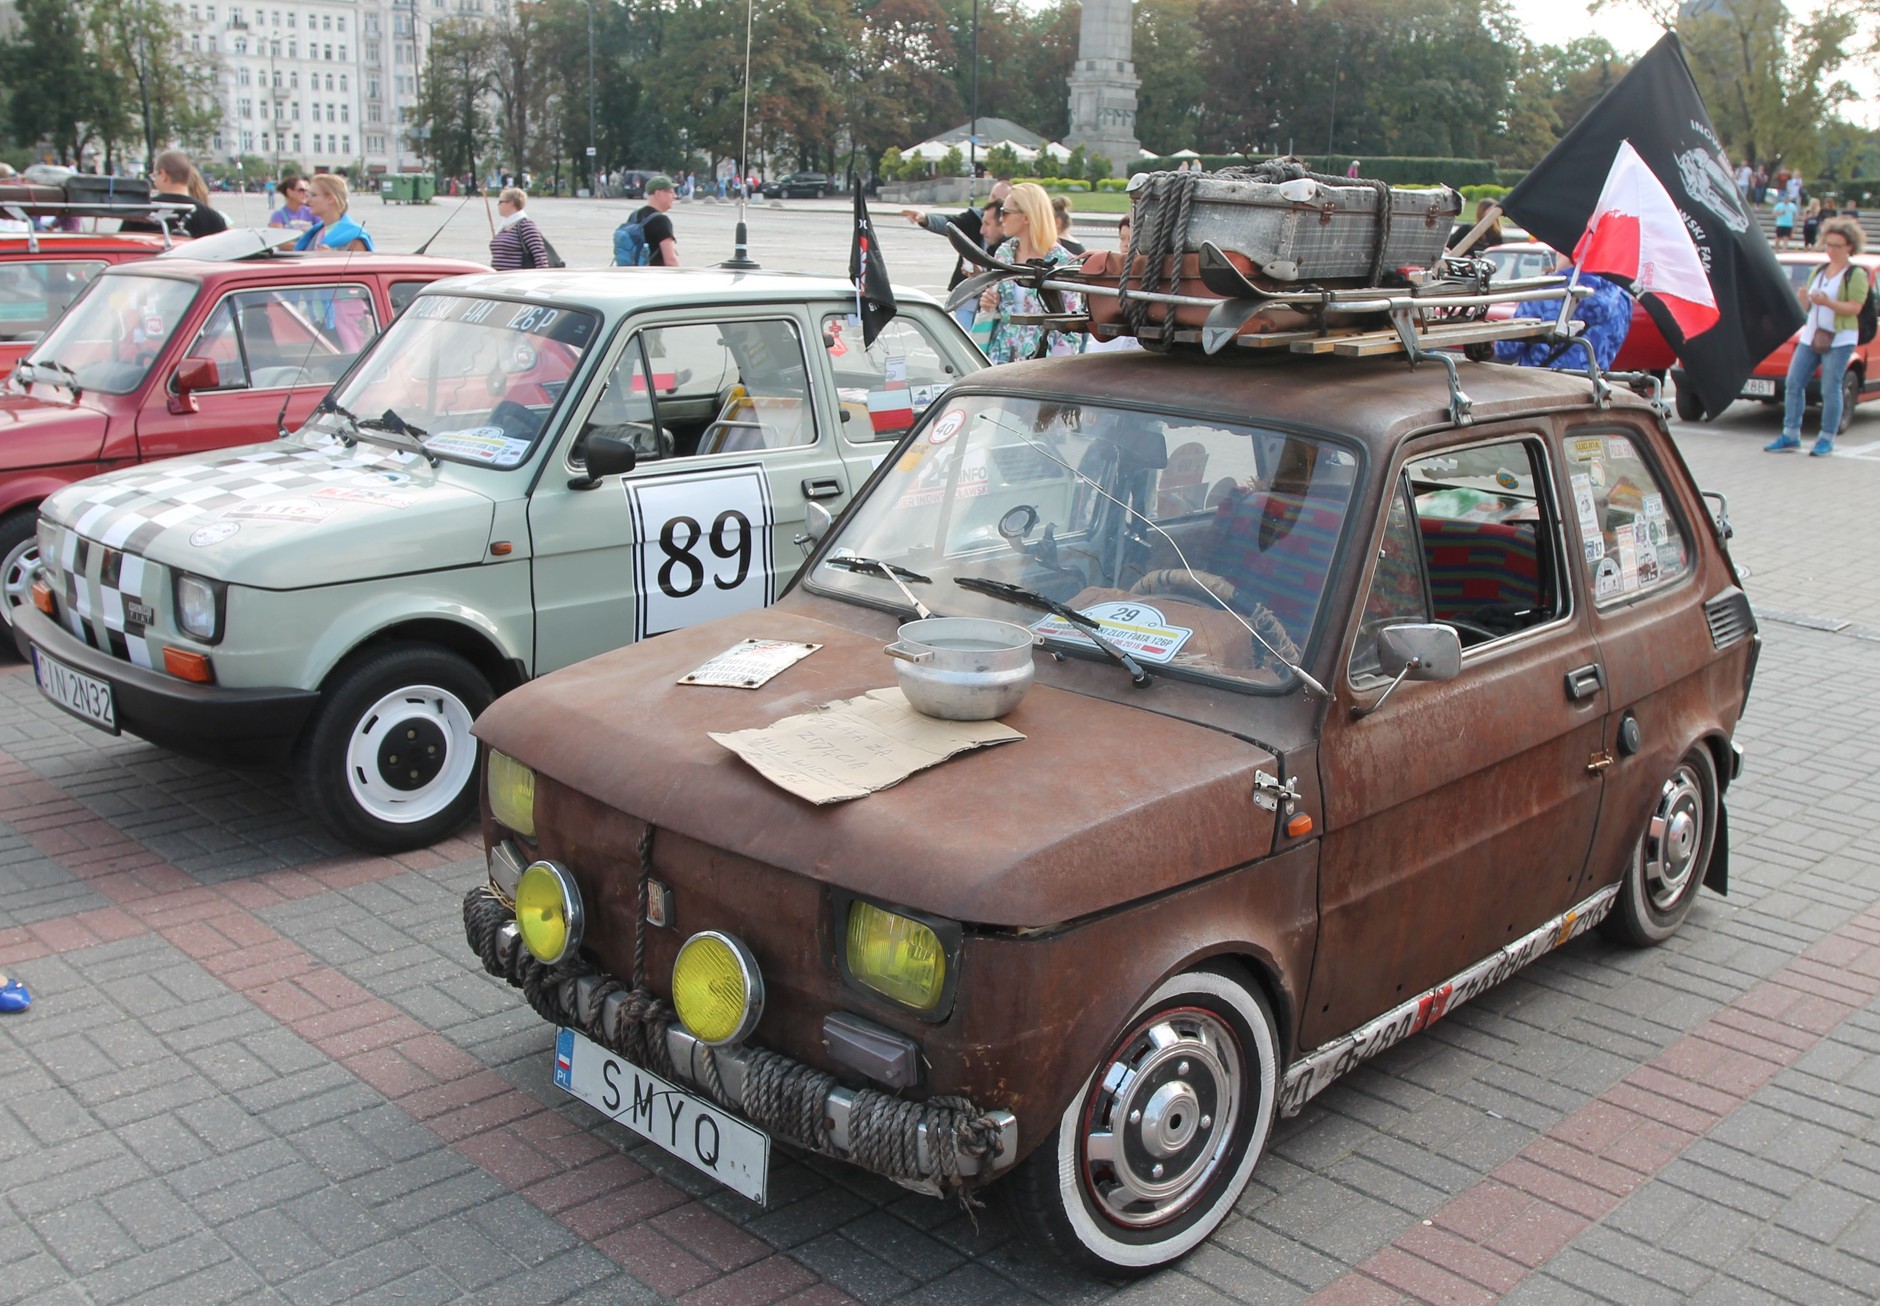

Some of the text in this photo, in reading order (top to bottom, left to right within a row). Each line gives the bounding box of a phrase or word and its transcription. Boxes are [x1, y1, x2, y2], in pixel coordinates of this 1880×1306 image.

[412, 296, 463, 320] POLSKI
[459, 299, 502, 324] FIAT
[935, 423, 955, 436] 40
[657, 508, 752, 599] 89
[129, 611, 152, 625] FIAT
[1108, 606, 1141, 622] 29
[1150, 635, 1174, 647] 126P
[69, 673, 114, 723] 2N32
[556, 1071, 569, 1086] PL
[602, 1058, 719, 1173] SMYQ
